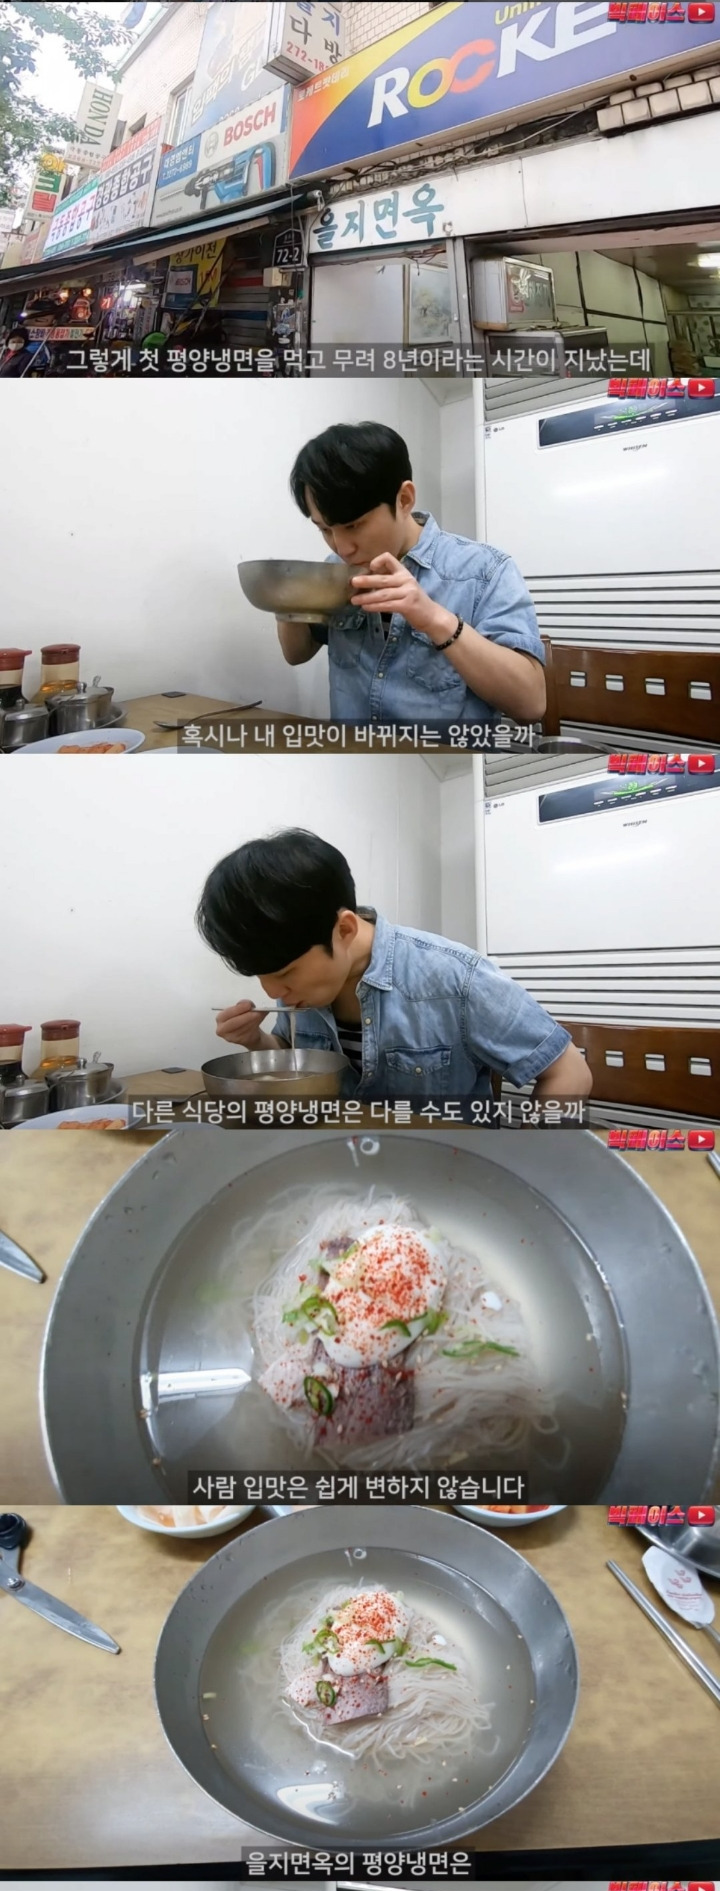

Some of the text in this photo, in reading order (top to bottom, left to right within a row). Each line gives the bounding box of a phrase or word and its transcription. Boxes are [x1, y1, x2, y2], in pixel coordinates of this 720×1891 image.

[289, 15, 342, 64] 다방
[223, 101, 277, 147] BOSCH
[313, 182, 447, 249] 을지면옥
[276, 247, 300, 264] 72-2
